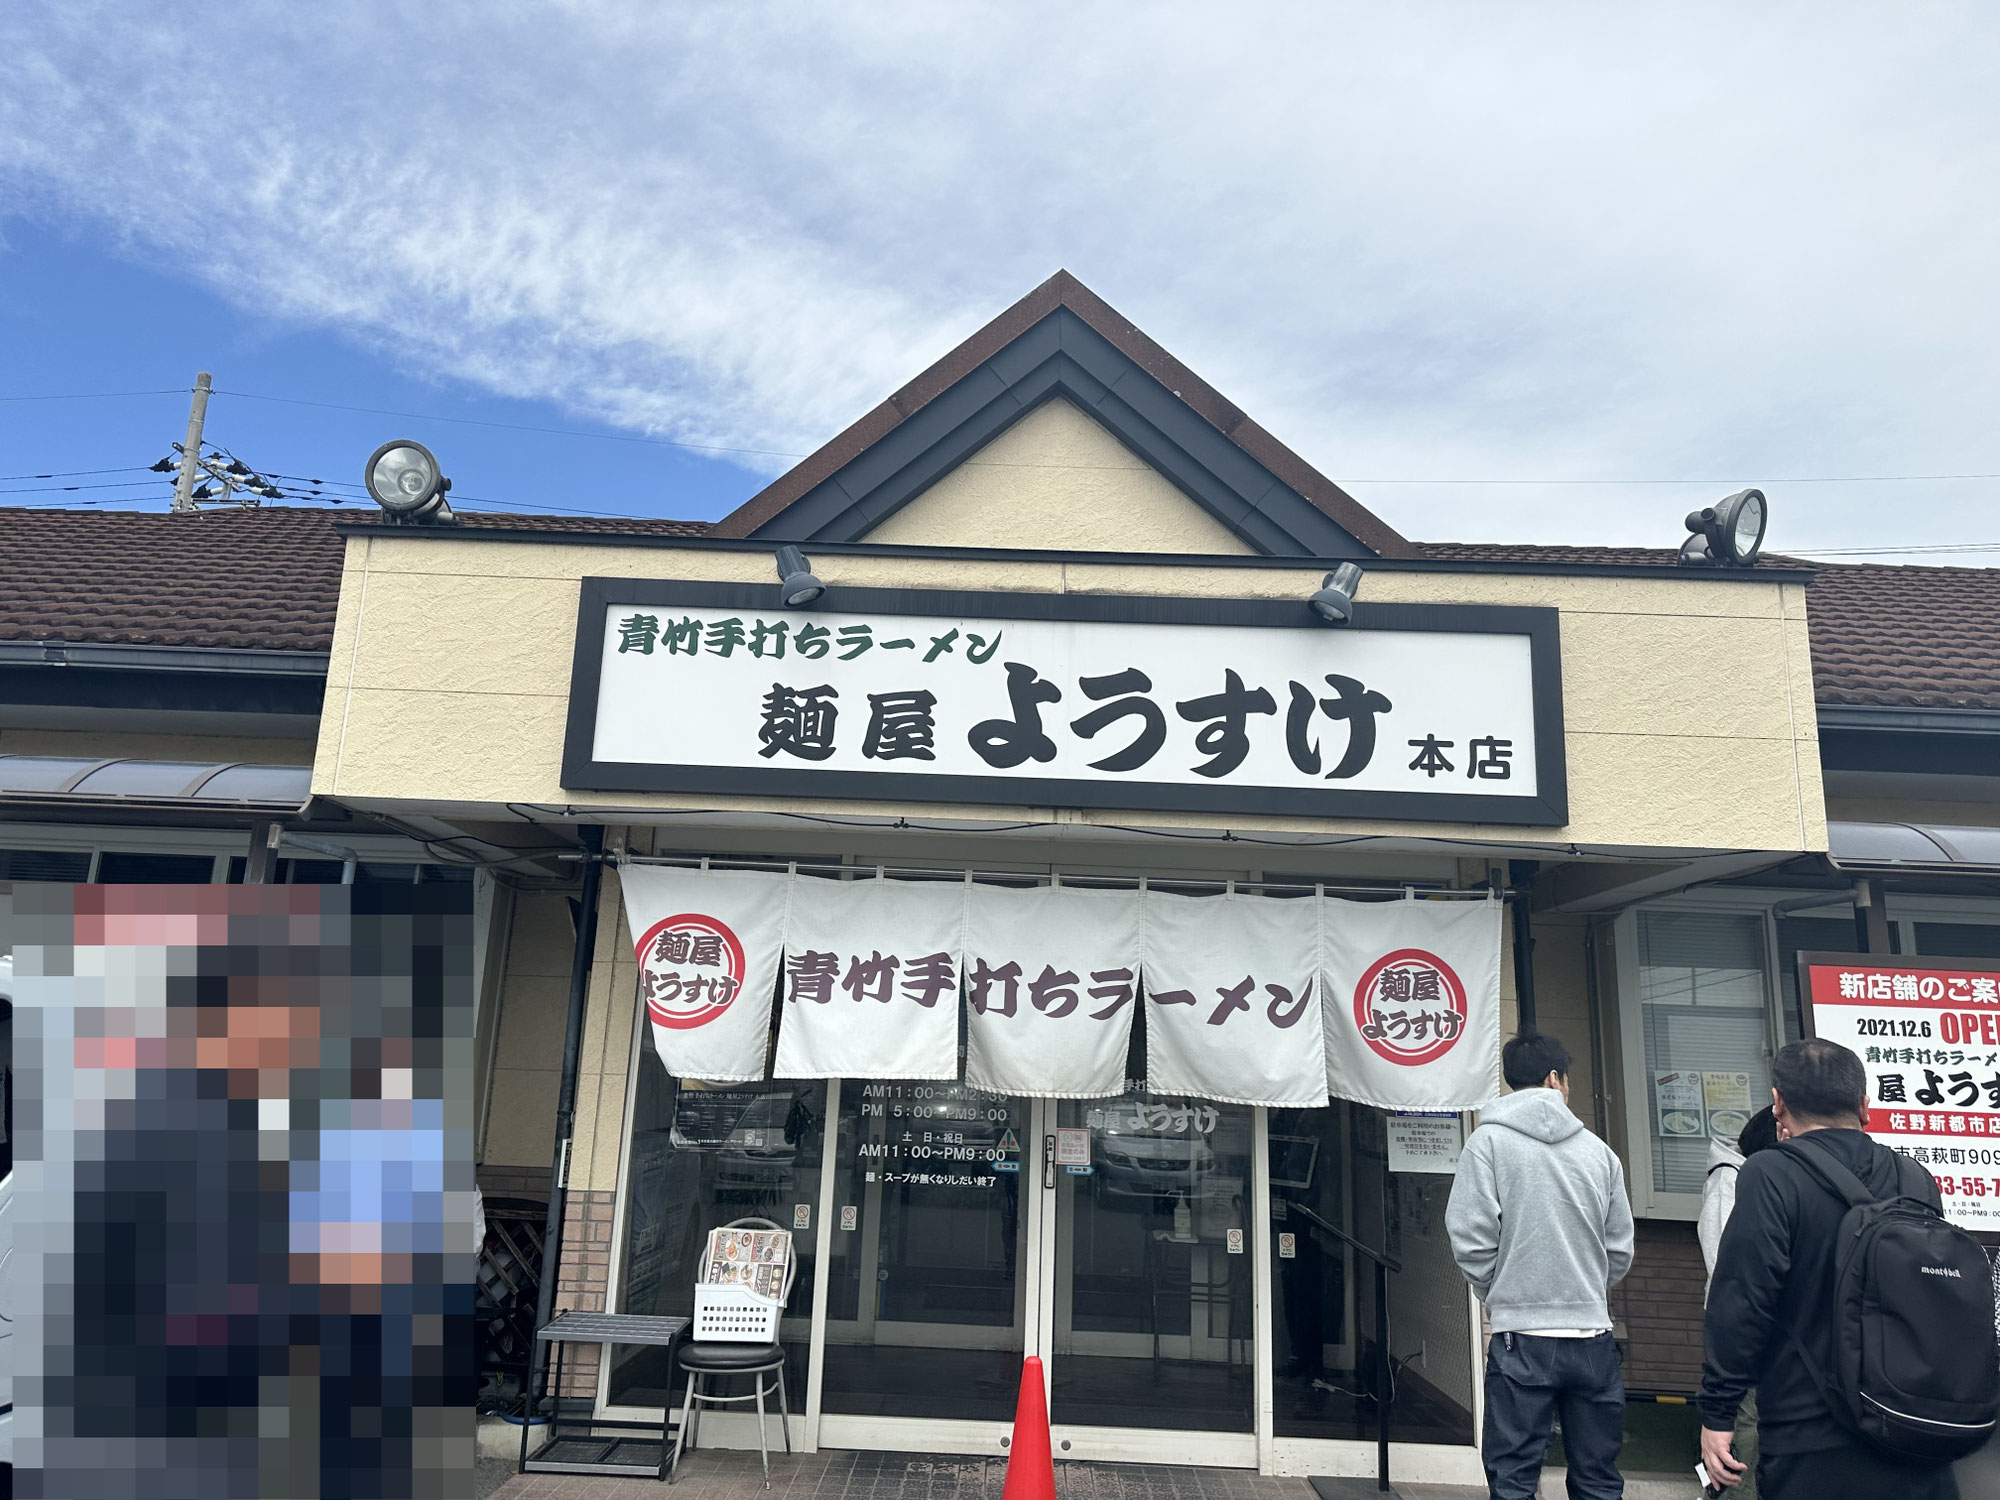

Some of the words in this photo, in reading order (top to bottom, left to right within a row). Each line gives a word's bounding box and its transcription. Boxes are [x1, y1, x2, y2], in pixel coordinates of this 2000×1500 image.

[617, 613, 1003, 665] 青竹手打ちラーメン
[758, 682, 938, 761] 麺屋
[967, 661, 1393, 779] ようすけ
[1408, 733, 1513, 780] 本店
[654, 930, 723, 967] 麺屋
[786, 949, 1313, 1030] 青竹手打ちラーメン
[1379, 968, 1441, 1002] 麺屋
[1838, 972, 2000, 1005] 新店舗のご案
[1361, 1008, 1462, 1041] ようすけ
[1856, 1018, 1932, 1038] 2021.12.6
[1939, 1012, 2000, 1046] OPE
[861, 1104, 883, 1117] PM
[1126, 1101, 1220, 1134] ようすけ
[1889, 1112, 2000, 1134] 佐野新都市店
